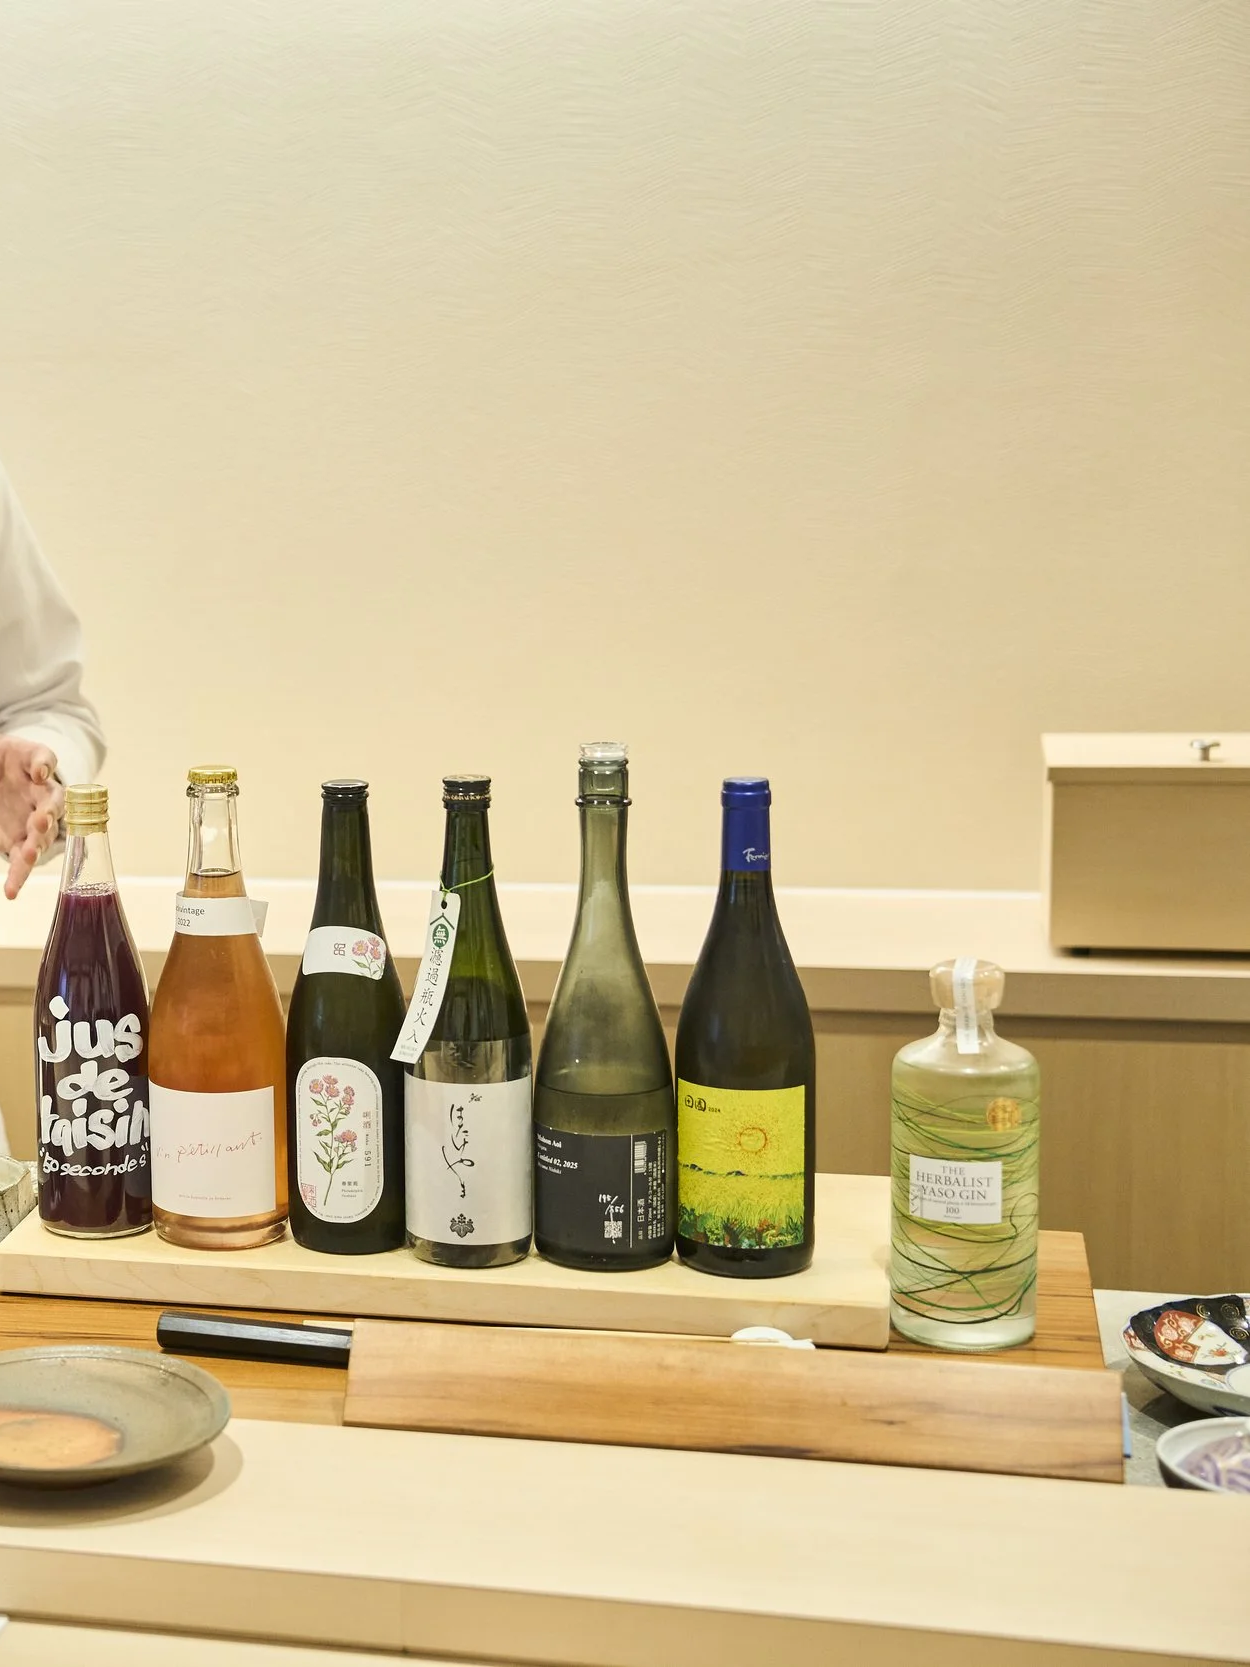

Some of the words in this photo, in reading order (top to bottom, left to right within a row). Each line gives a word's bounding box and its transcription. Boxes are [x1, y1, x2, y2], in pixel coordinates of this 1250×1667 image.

[177, 917, 191, 927] 2022
[37, 995, 144, 1063] jus
[56, 1060, 134, 1101] de
[40, 1094, 150, 1157] raisin
[562, 1160, 578, 1169] 2025
[941, 1165, 966, 1176] THE
[916, 1170, 993, 1188] HERBALIST
[921, 1184, 955, 1199] YASO
[959, 1189, 987, 1200] GIN
[637, 1198, 645, 1222] 日本酒
[945, 1206, 960, 1214] 100
